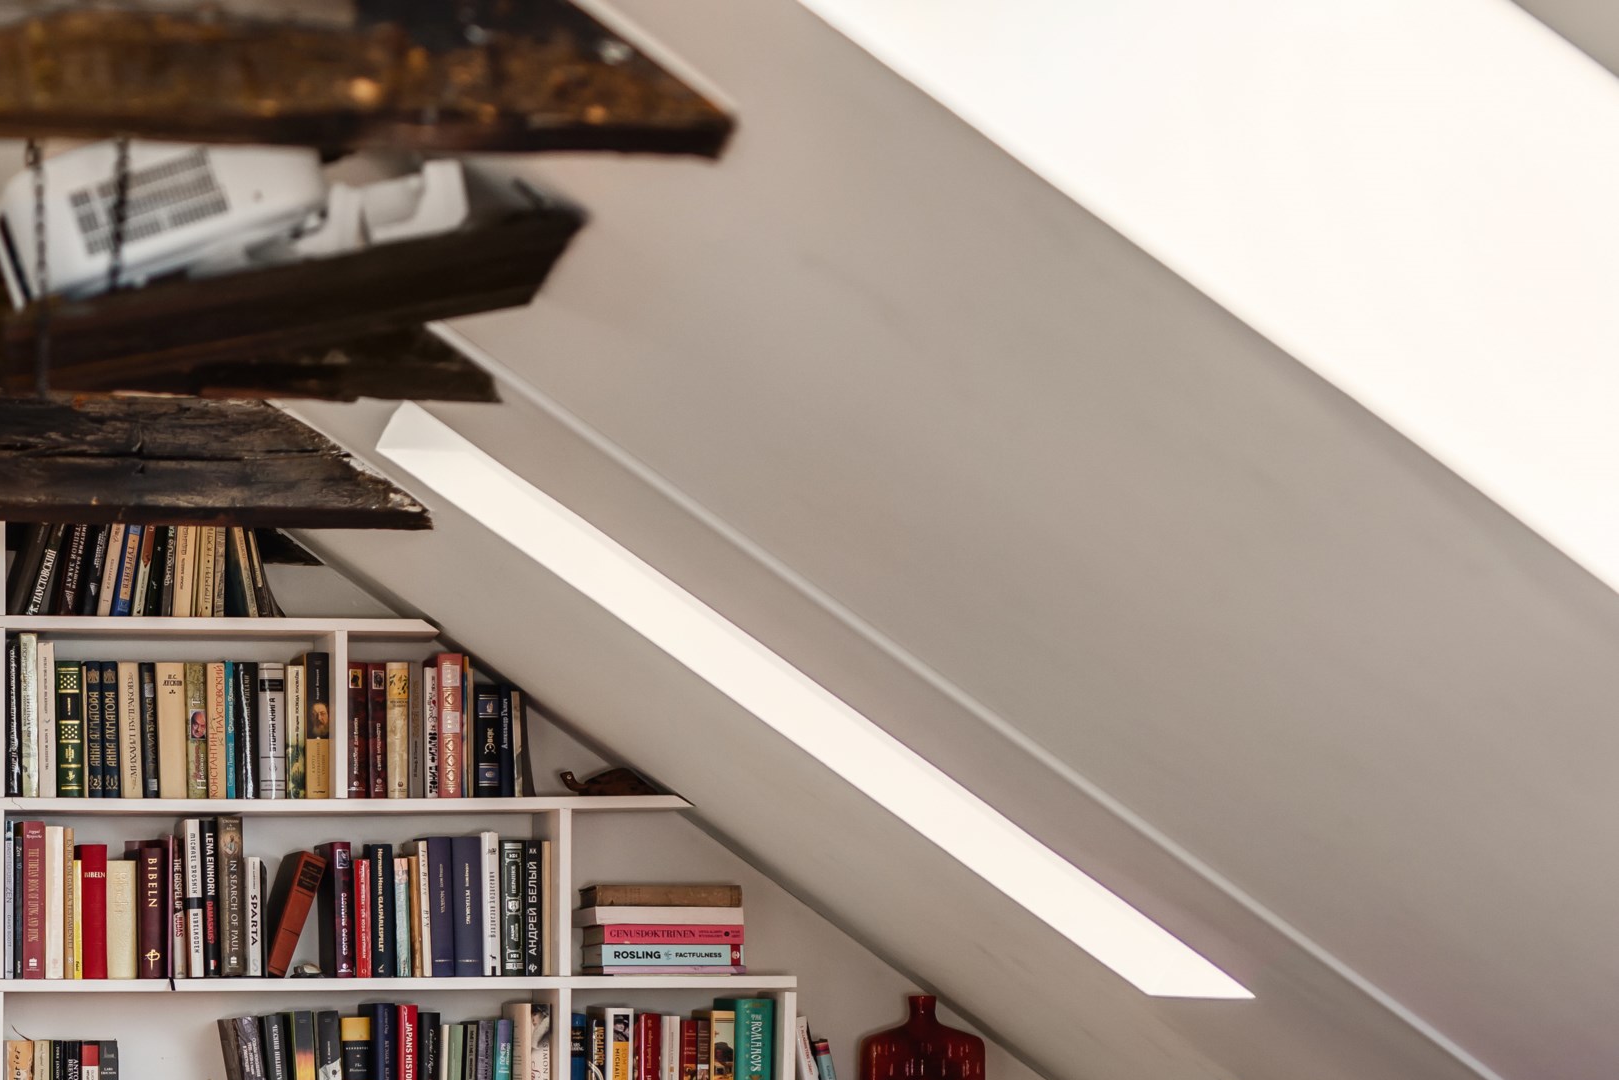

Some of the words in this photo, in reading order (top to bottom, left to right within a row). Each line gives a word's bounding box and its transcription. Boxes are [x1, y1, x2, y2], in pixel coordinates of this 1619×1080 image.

[209, 732, 218, 798] КОНСТАНТИН
[28, 848, 40, 857] THE
[206, 833, 214, 855] LENA
[28, 859, 40, 878] TIBETAN
[230, 860, 237, 870] IN
[28, 879, 40, 892] BOOK
[148, 857, 158, 908] BIBELN
[174, 872, 182, 899] GOSPEL
[207, 857, 215, 895] EINHORN
[529, 861, 538, 903] БЕЛЫЙ
[230, 874, 238, 911] SEARCH
[28, 901, 39, 916] LIVING
[175, 900, 183, 909] OF
[28, 917, 39, 927] AND
[175, 914, 183, 937] JUDAS
[231, 914, 238, 927] OF
[250, 894, 258, 946] SPARTA
[28, 928, 39, 942] DYING
[528, 907, 538, 955] АНДРЕЙ
[609, 929, 695, 938] GENUSDOKTRINEN
[614, 951, 661, 959] ROSLING
[405, 1022, 413, 1053] JAPANS
